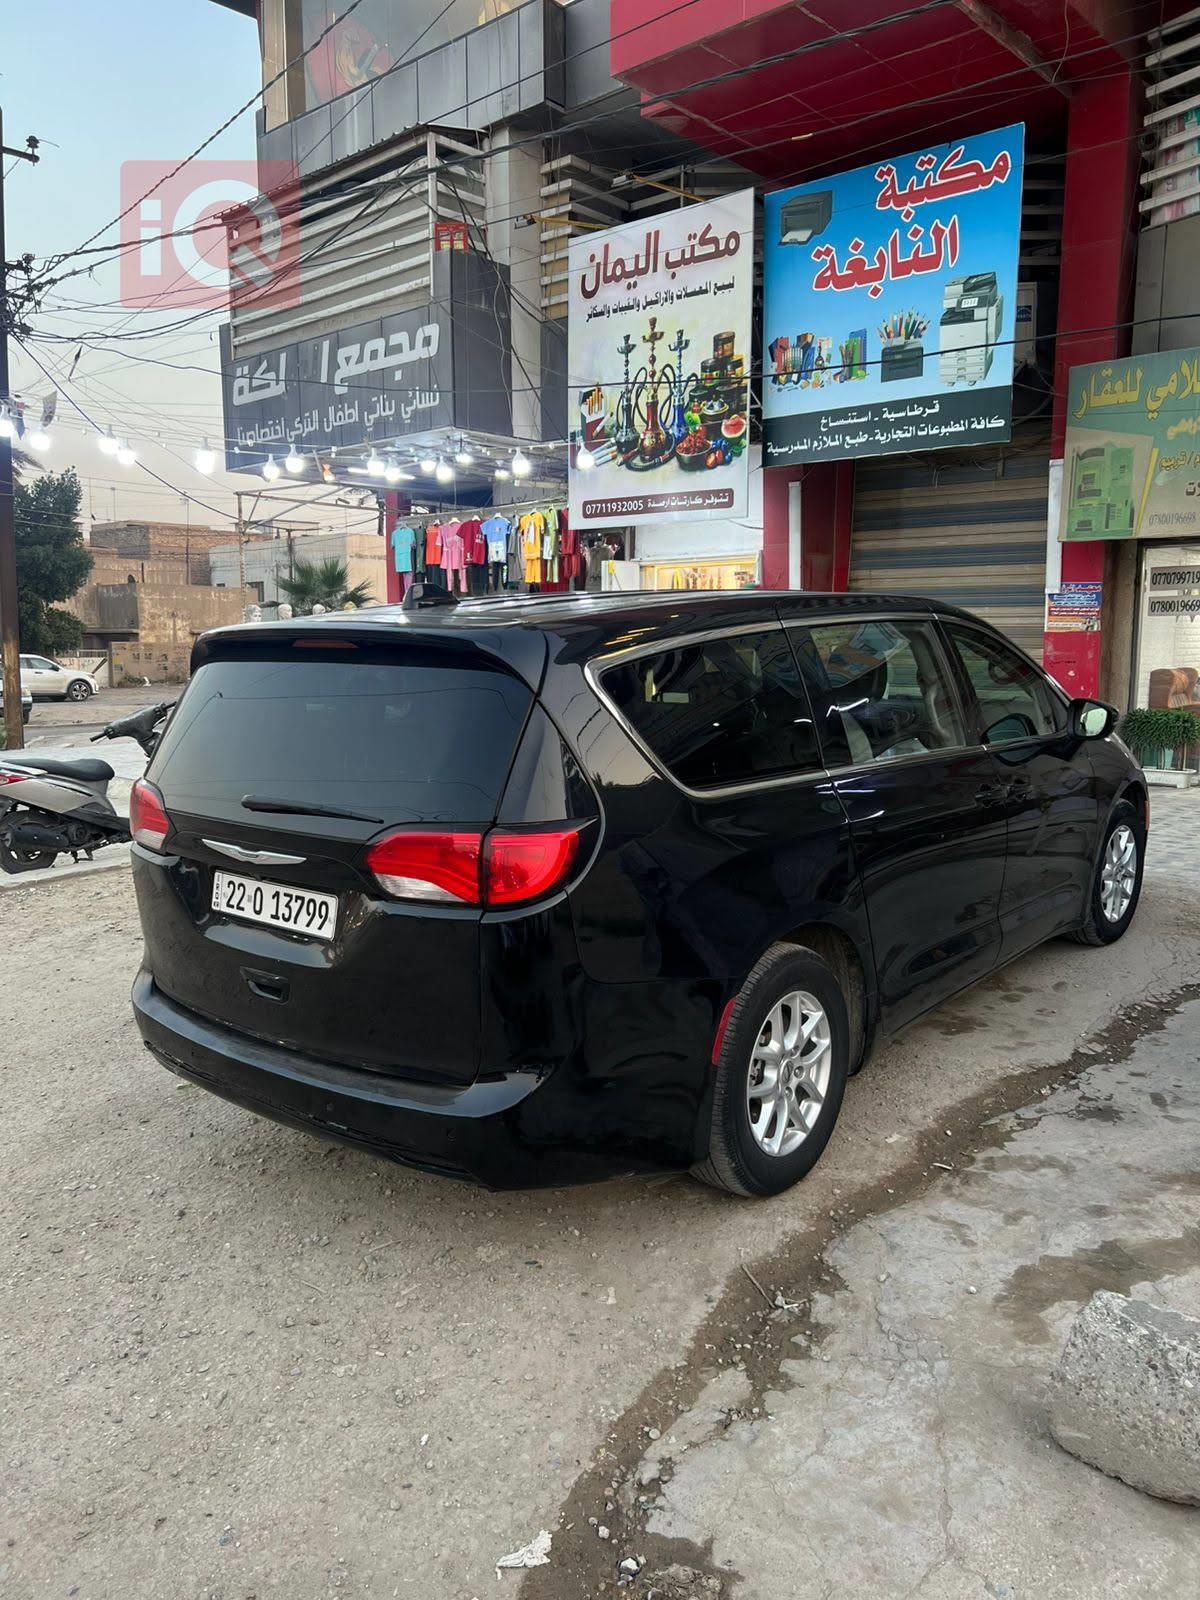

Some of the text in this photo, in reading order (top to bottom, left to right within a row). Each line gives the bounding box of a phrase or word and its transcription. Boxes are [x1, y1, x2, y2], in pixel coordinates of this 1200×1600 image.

[875, 145, 1011, 222] مكتبة
[580, 223, 741, 300] مكتب اليمان
[811, 214, 960, 299] النابغة
[675, 280, 712, 300] المعسلات
[713, 275, 735, 296] لبيع
[642, 289, 674, 311] والاراكيل
[334, 322, 440, 395] مجمع
[401, 383, 440, 424] نسائي
[1072, 366, 1144, 420] للعقار
[323, 400, 359, 433] اطفال
[364, 393, 395, 431] بناتي
[881, 399, 940, 420] قرطاسية
[820, 410, 872, 431] استنساخ
[917, 420, 968, 437] المطبوعات
[969, 415, 1006, 430] كافة
[812, 434, 842, 451] الملازم
[843, 431, 869, 448] طبع
[874, 426, 916, 444] التجارية
[766, 437, 811, 456] المدرسية
[585, 499, 644, 515] 07711932005
[703, 492, 729, 506] تتوفر
[226, 880, 247, 911] 22
[270, 890, 330, 931] 13799
